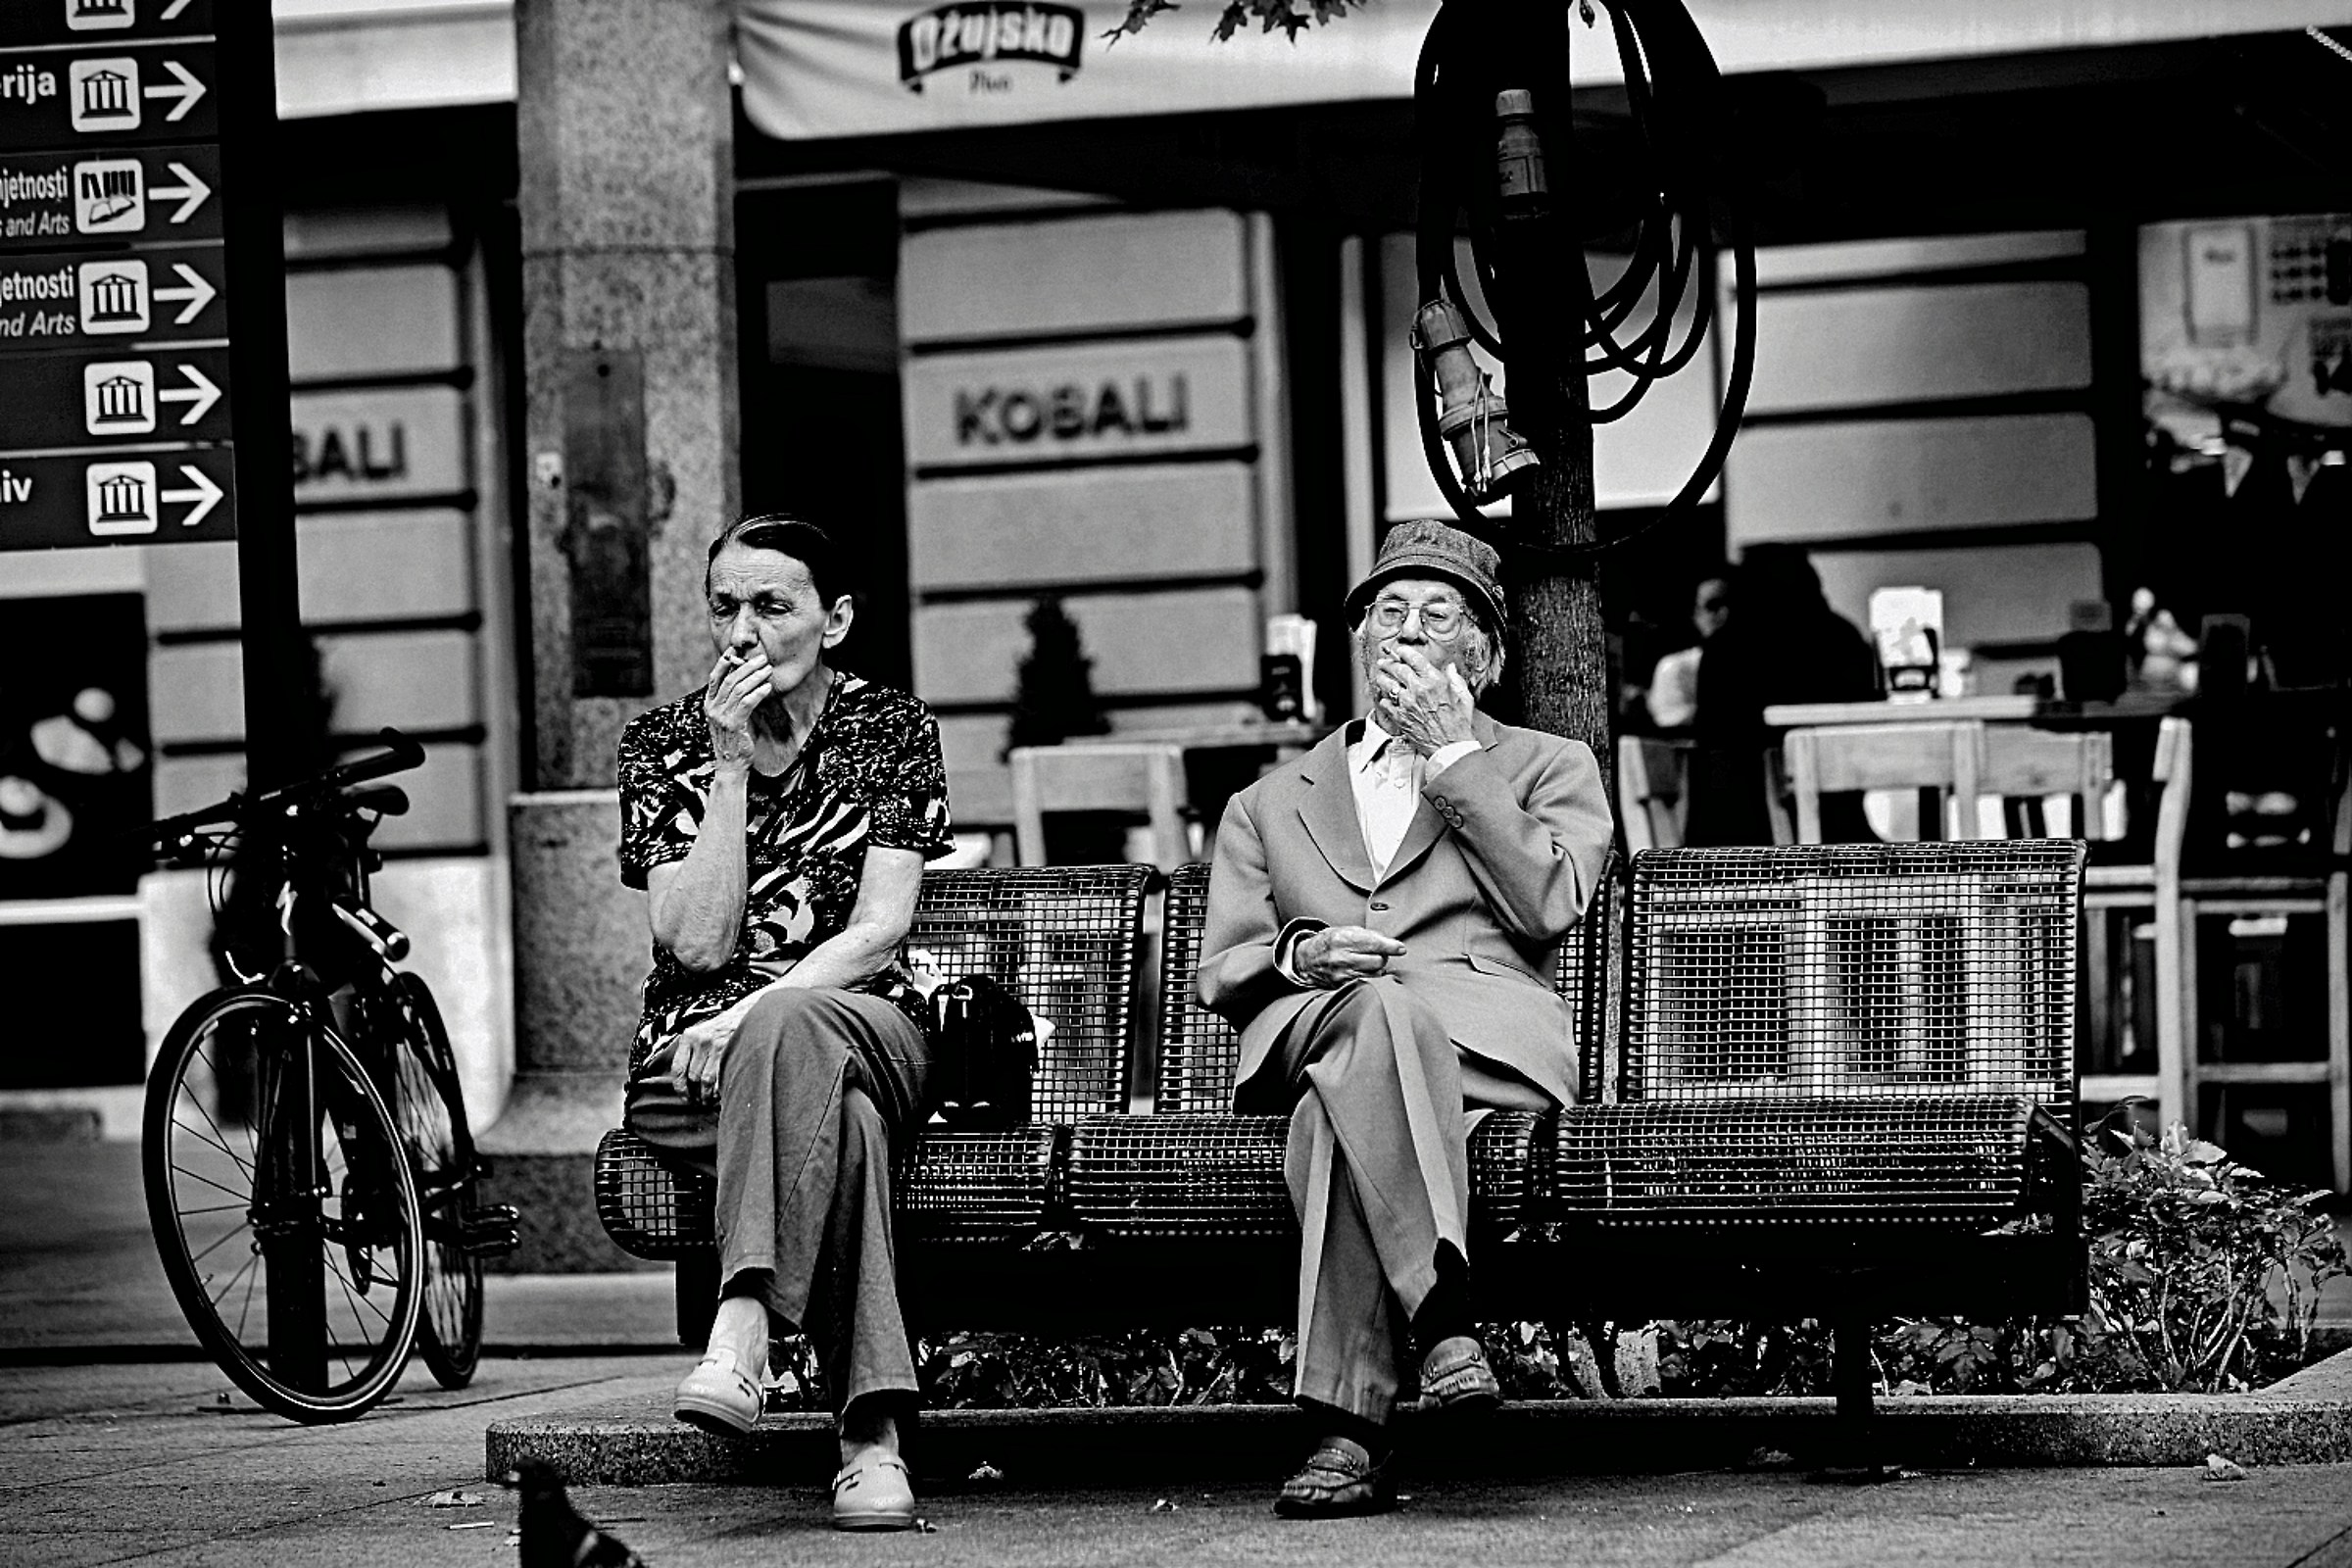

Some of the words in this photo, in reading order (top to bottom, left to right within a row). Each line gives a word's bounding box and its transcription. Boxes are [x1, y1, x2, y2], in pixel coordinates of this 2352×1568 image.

[0, 64, 57, 105] rija
[6, 211, 35, 237] and
[37, 209, 70, 236] Arts
[0, 264, 74, 308] etnosti
[28, 309, 75, 337] Arts
[954, 369, 1188, 446] KOBALI
[0, 468, 32, 503] iv
